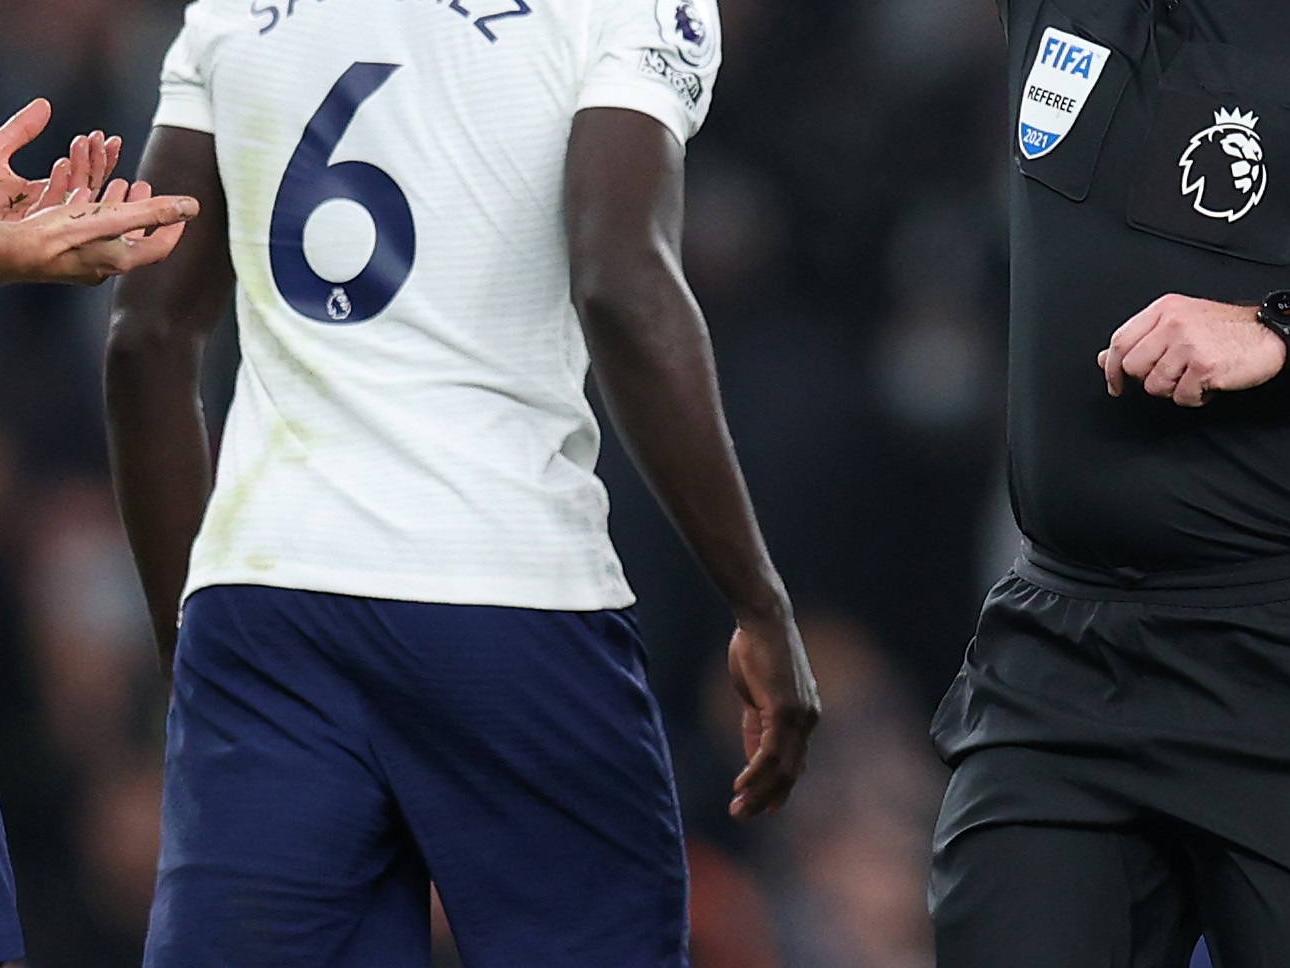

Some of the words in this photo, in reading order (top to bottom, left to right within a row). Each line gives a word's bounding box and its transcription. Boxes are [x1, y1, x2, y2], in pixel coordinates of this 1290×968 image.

[1041, 36, 1094, 80] FIFA
[1028, 85, 1076, 113] REFEREE
[1023, 128, 1049, 149] 2021
[269, 61, 417, 324] 6
